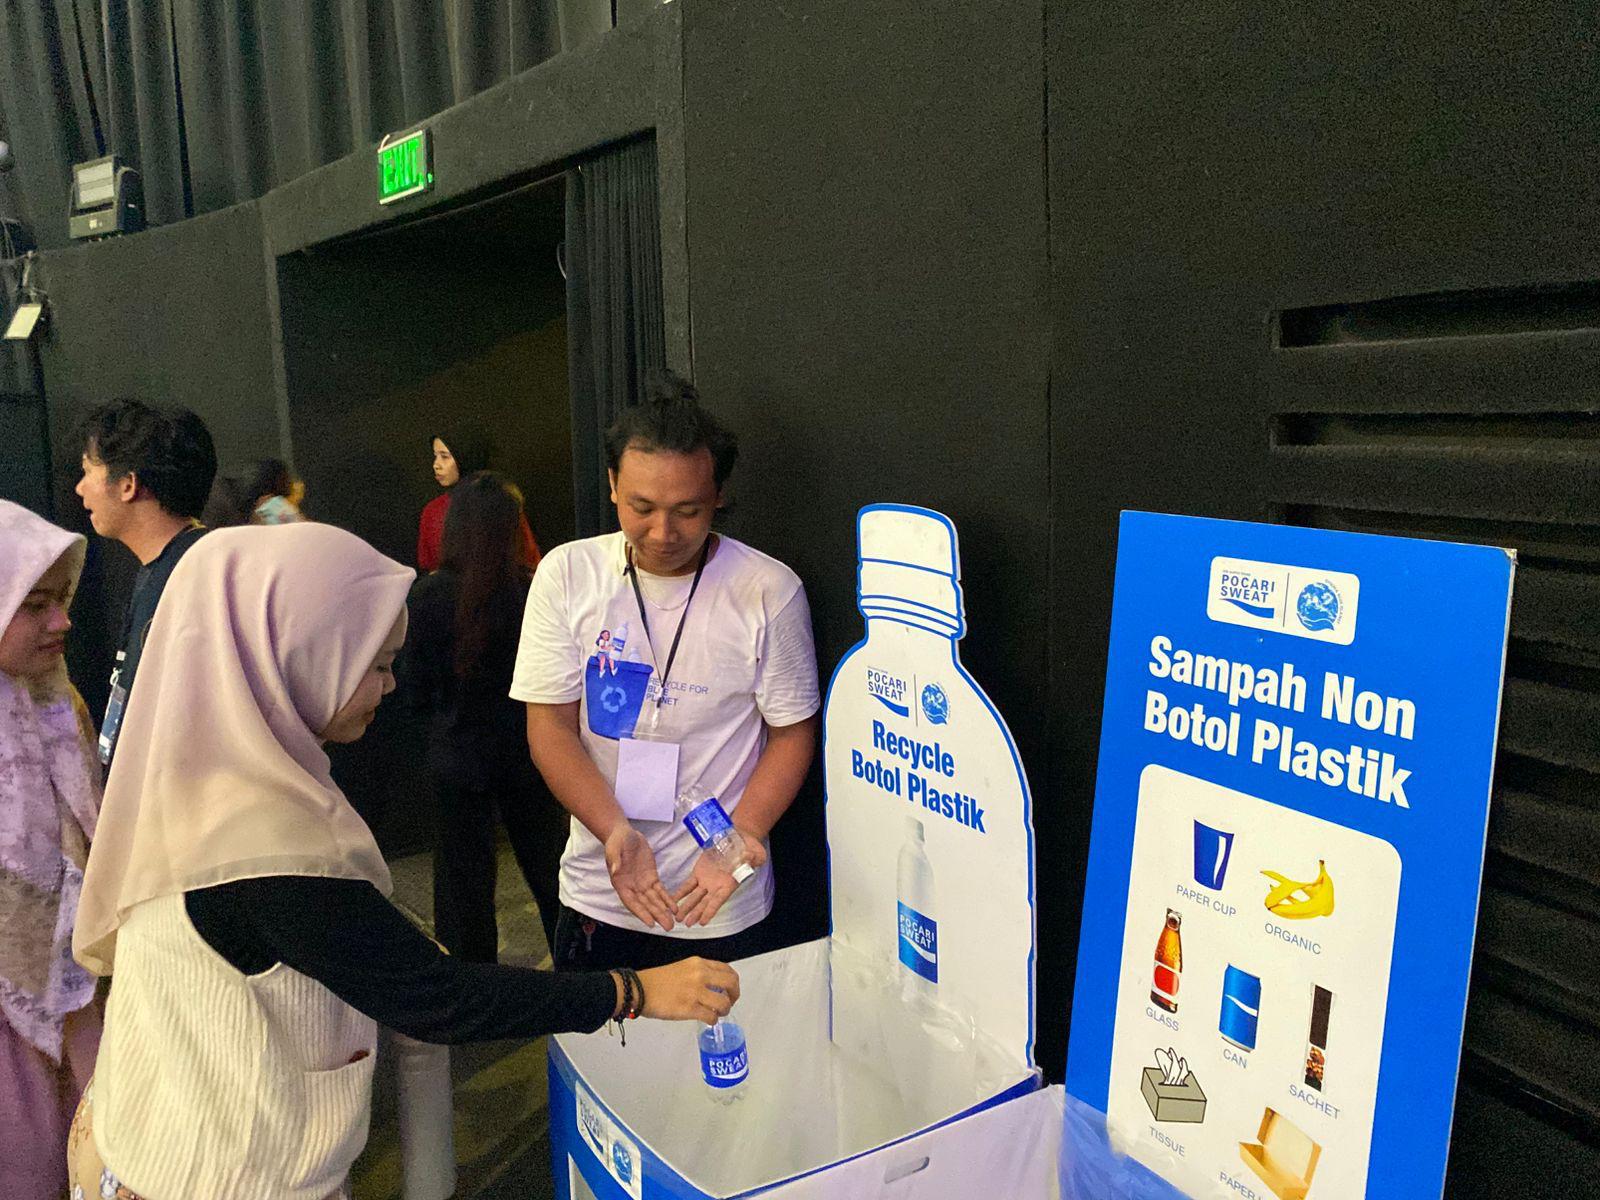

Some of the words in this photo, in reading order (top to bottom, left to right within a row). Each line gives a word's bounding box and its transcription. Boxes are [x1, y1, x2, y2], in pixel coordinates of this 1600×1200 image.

[383, 138, 419, 194] EXIT
[1220, 585, 1269, 603] SWEAT
[1221, 574, 1275, 593] POCARI
[647, 685, 669, 697] BLE
[649, 678, 687, 692] REYCLE
[689, 684, 709, 695] FOR
[867, 670, 907, 692] POCARI
[868, 681, 904, 702] SWEAT
[1148, 635, 1307, 712] Sampah
[1321, 672, 1416, 740] Non
[646, 693, 679, 706] PLNET
[872, 719, 956, 777] Recycle
[1144, 690, 1241, 757] Botol
[1251, 719, 1413, 809] Plastik
[851, 749, 902, 796] Botol
[907, 771, 987, 834] Plastik
[1176, 884, 1211, 908] PAPER
[1213, 897, 1237, 917] CUP
[899, 914, 935, 942] POCARI
[899, 924, 932, 949] SWEAT
[1264, 922, 1322, 955] ORGANIC
[1145, 1006, 1180, 1032] GLASS
[709, 1051, 746, 1067] POCAR
[1222, 1048, 1248, 1069] CAN
[1289, 1084, 1341, 1120] SACHET
[1149, 1126, 1186, 1157] TISSUE
[1219, 1171, 1256, 1200] PAPER
